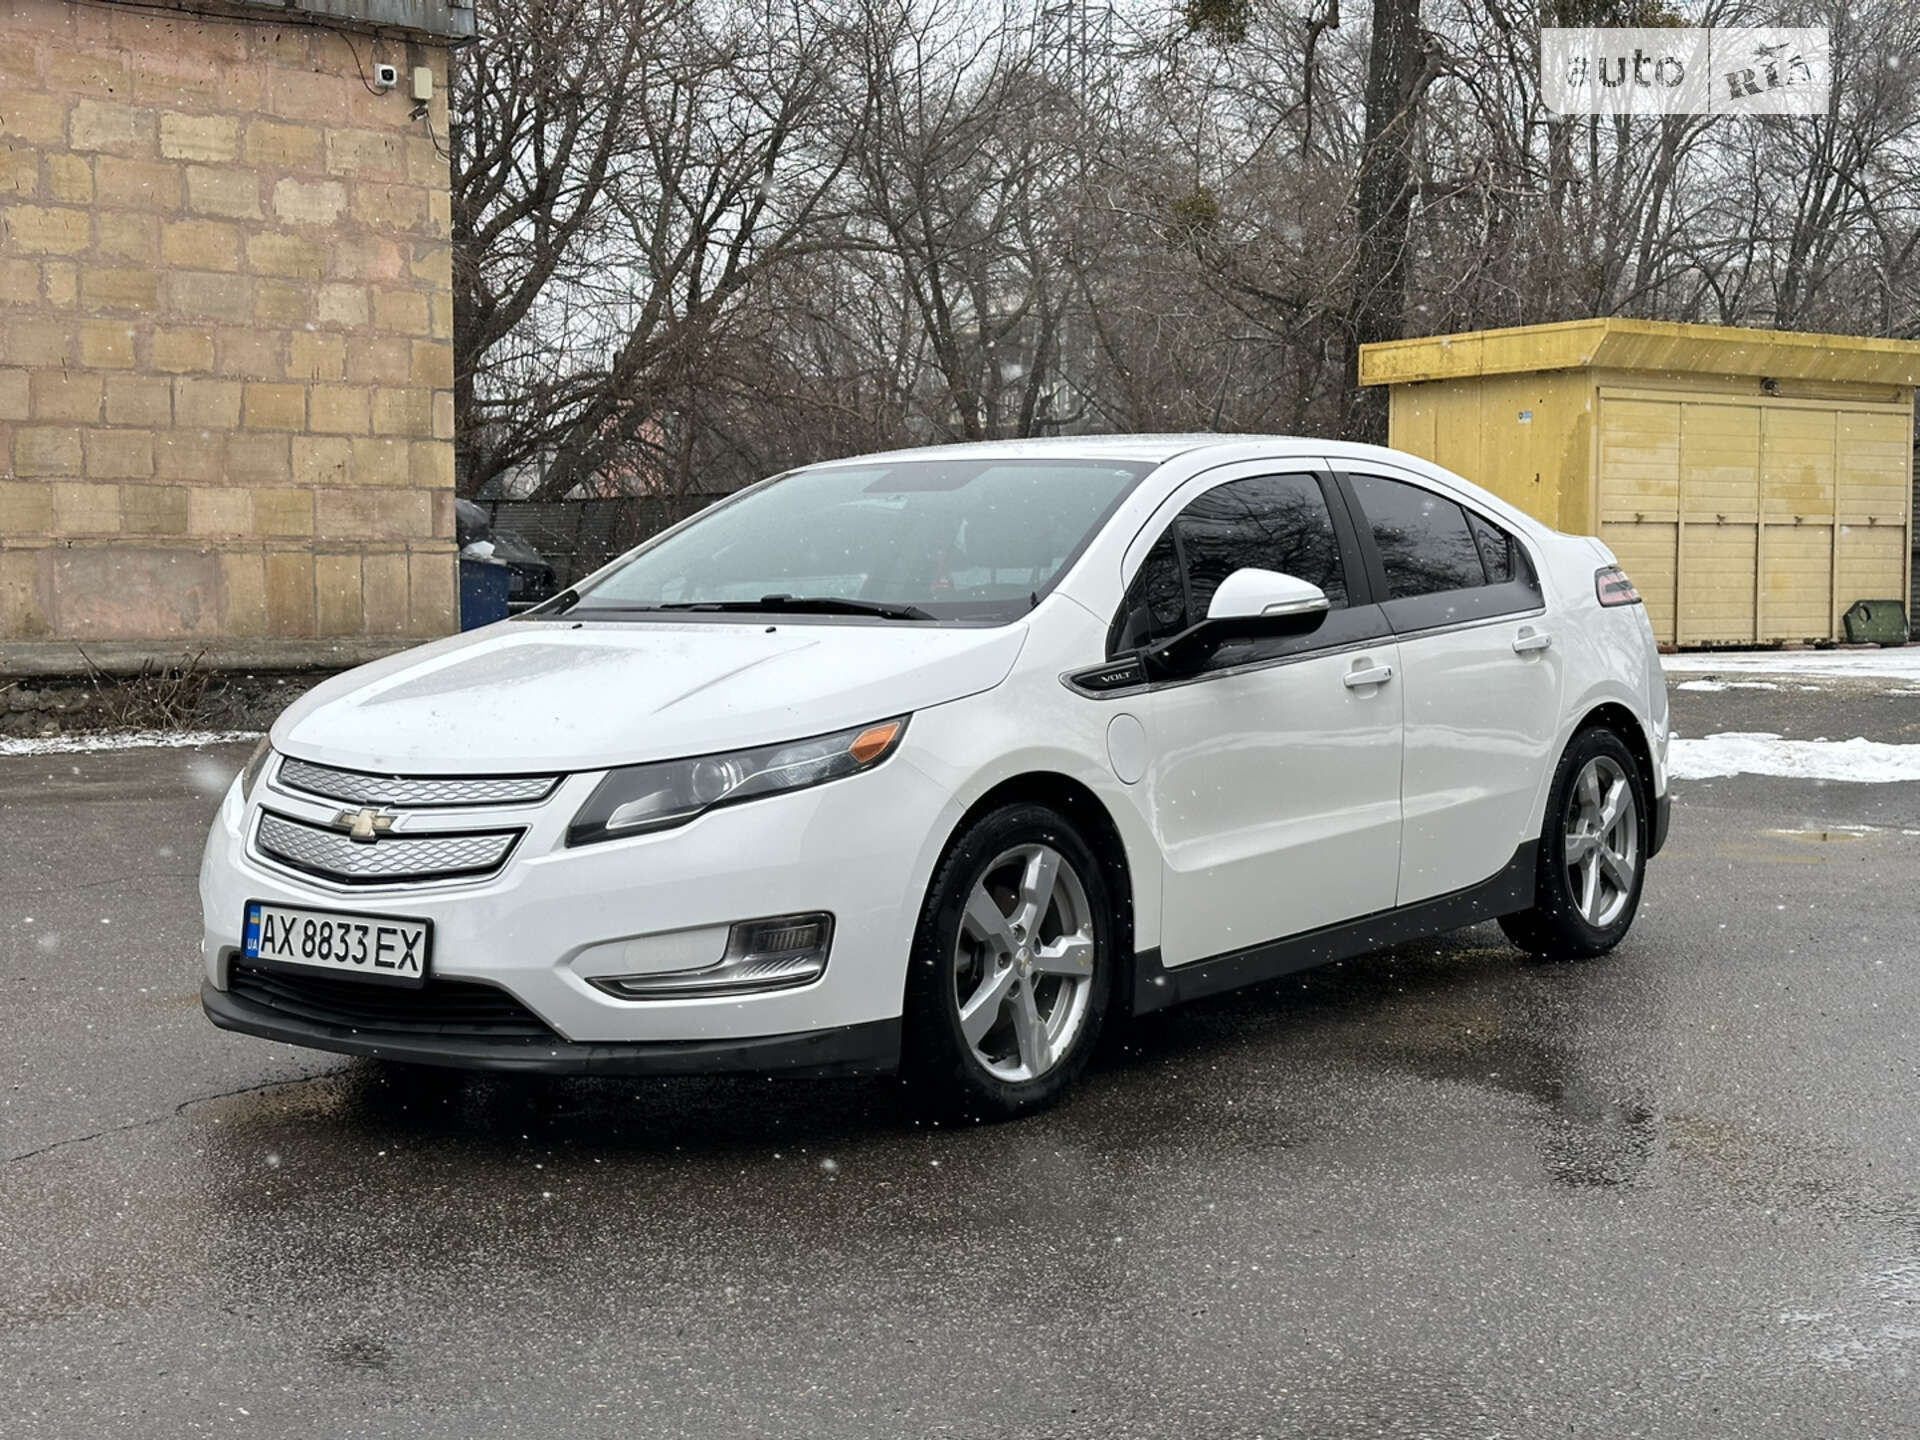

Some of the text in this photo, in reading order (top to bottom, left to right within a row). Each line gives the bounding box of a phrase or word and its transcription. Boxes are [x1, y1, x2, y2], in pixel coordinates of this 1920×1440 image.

[1101, 671, 1131, 682] VOLT
[247, 938, 258, 950] UA
[260, 914, 422, 971] AX 8833 EX
